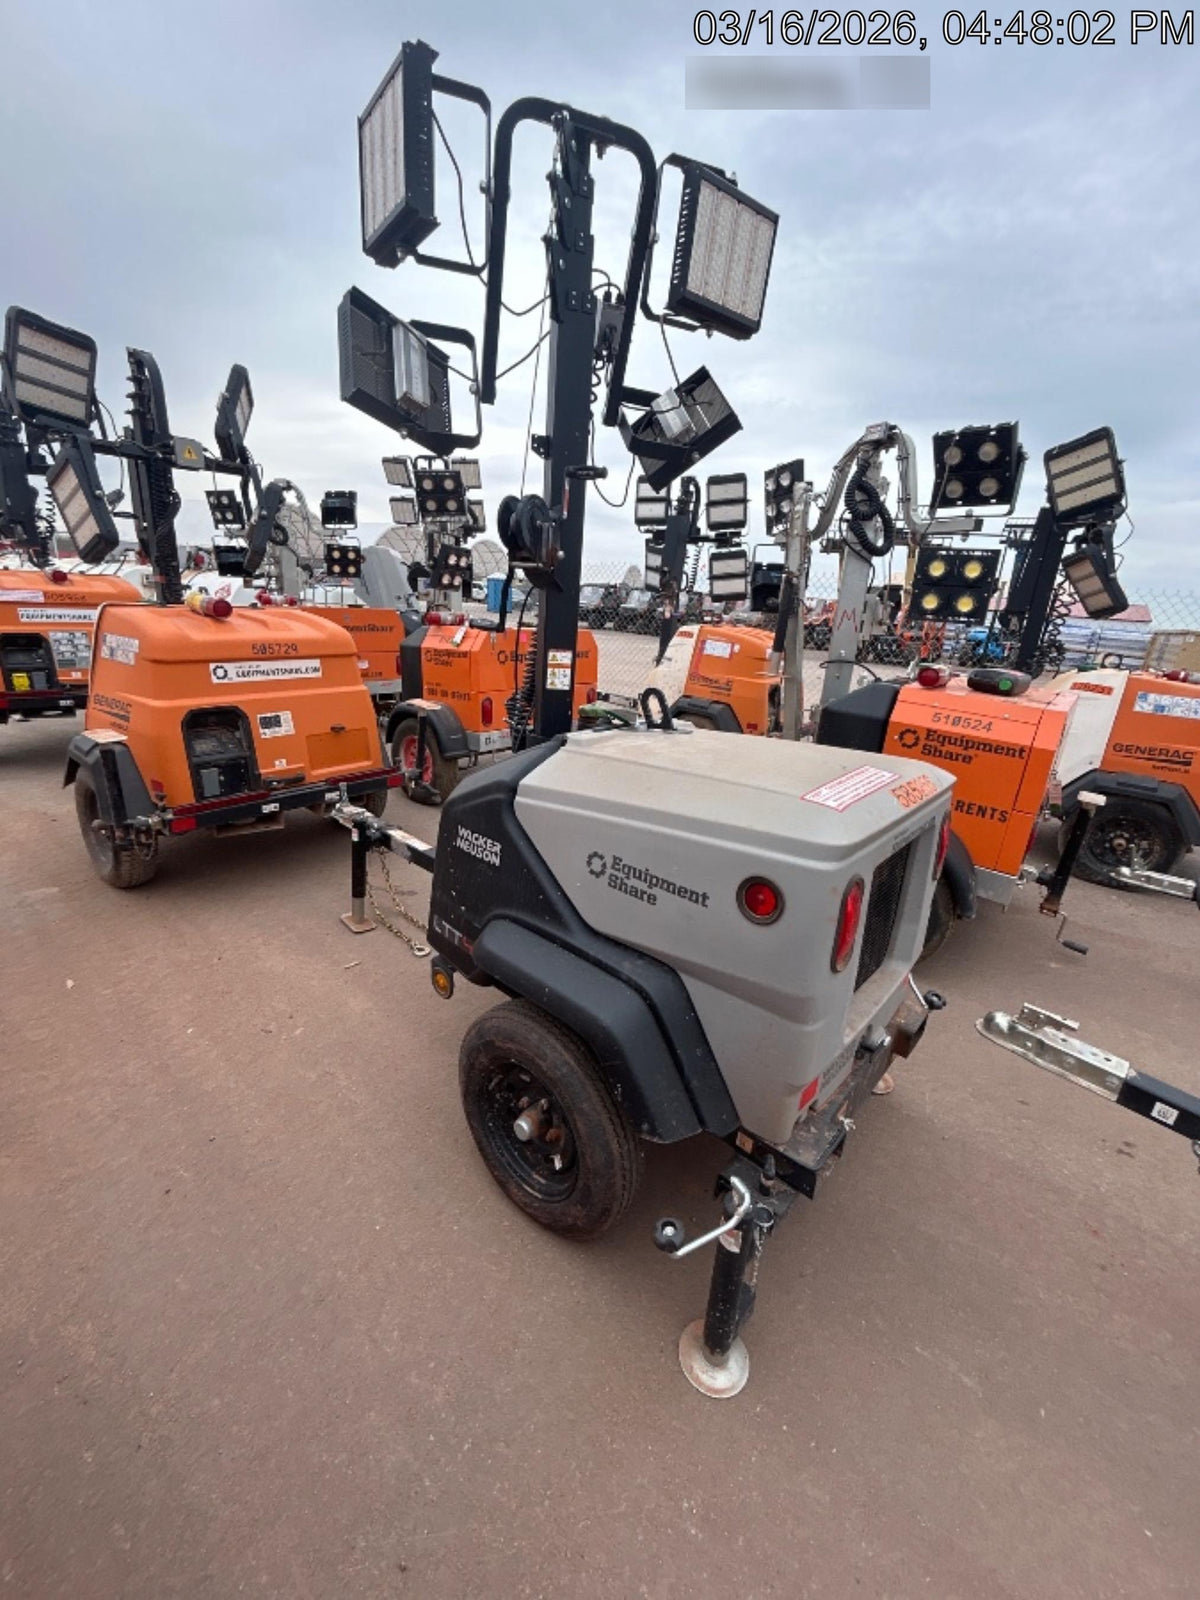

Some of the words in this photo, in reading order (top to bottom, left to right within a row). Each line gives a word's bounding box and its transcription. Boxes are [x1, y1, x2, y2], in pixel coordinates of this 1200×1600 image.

[251, 643, 299, 655] 505729
[931, 711, 993, 732] 510524
[920, 743, 974, 765] Share
[924, 728, 1027, 760] Equipment
[1112, 742, 1195, 760] GENERAC
[456, 836, 500, 867] NEUSON
[457, 825, 502, 854] WACKER
[607, 873, 657, 906] Share
[610, 854, 710, 908] Equipment
